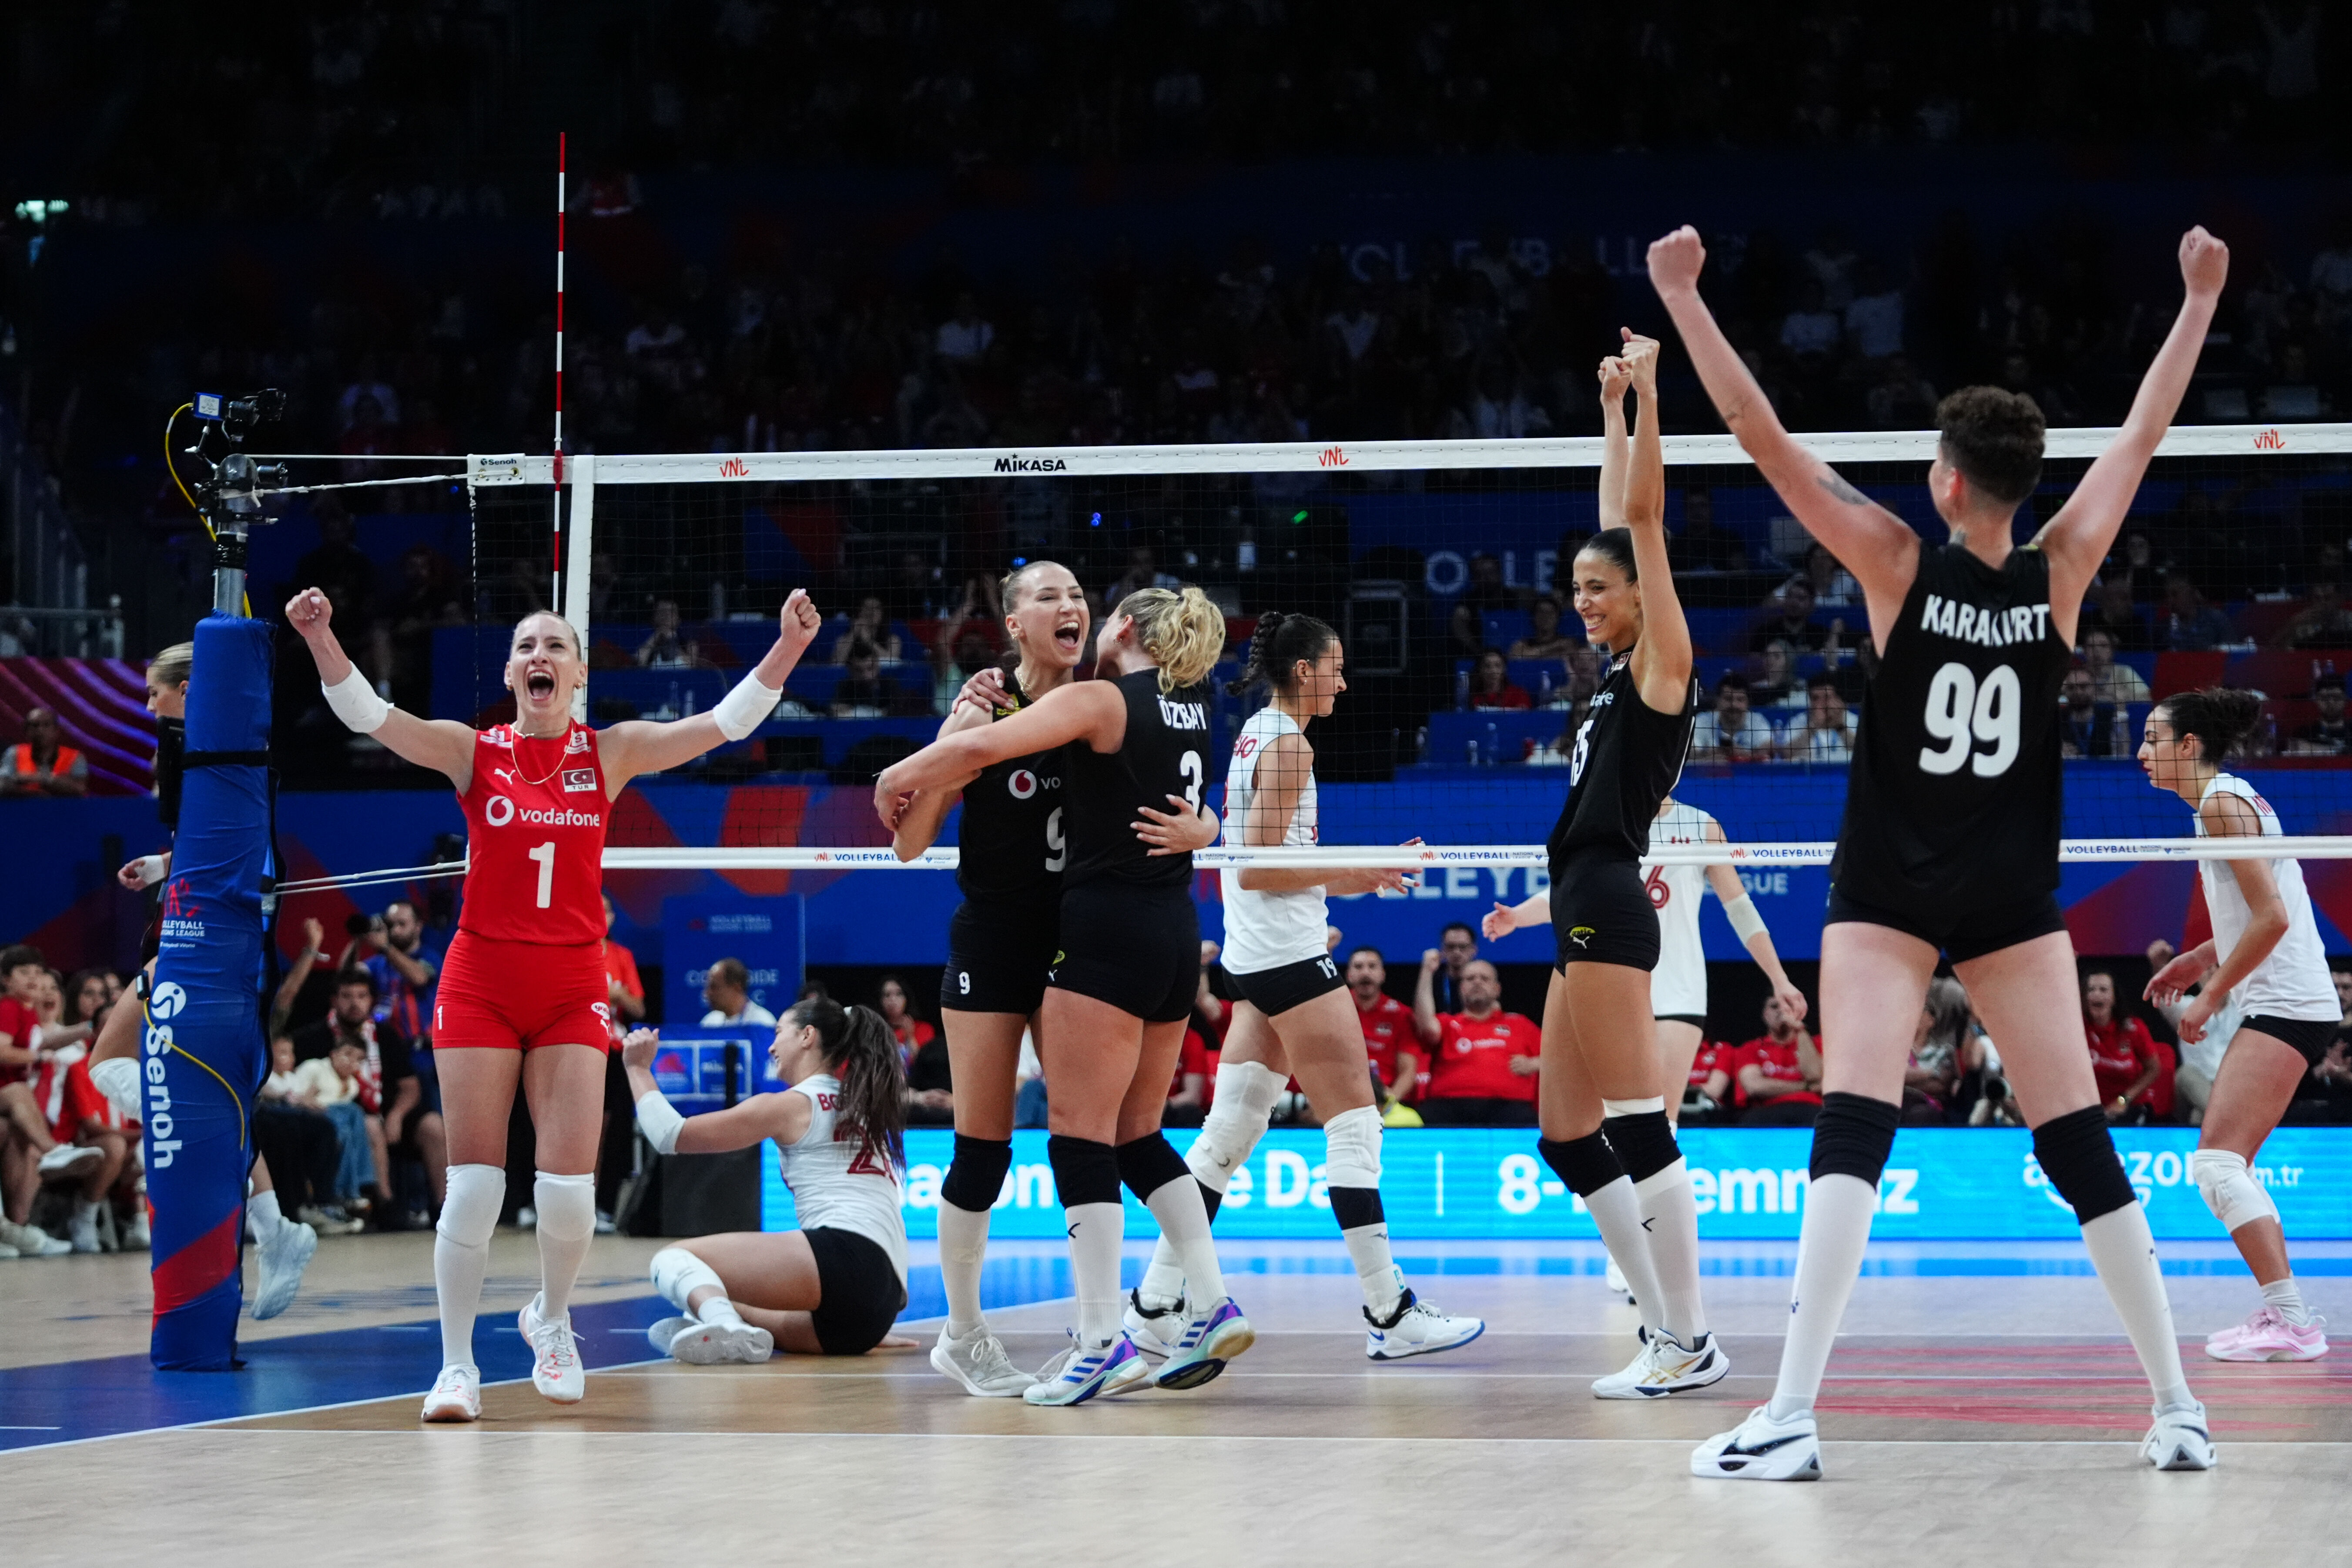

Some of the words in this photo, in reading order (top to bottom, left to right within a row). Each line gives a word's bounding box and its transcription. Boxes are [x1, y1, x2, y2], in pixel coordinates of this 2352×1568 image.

[2254, 429, 2285, 449] VNL
[720, 457, 749, 477] VNL
[1319, 446, 1349, 466] VNL
[1156, 693, 1207, 730] ÖZBAY
[1919, 662, 2021, 778] 99
[1180, 750, 1203, 818] 3
[519, 808, 600, 826] vodafone
[1420, 850, 1437, 861] VNL
[1730, 847, 1748, 858] VNL
[1752, 849, 1823, 857] VOLLEYBALL
[2067, 845, 2138, 854] VOLLEYBALL
[529, 841, 555, 908] 1
[1645, 865, 1670, 909] 6
[1316, 957, 1338, 979] 19
[959, 972, 970, 995] 9
[437, 1005, 443, 1030] 1
[146, 1024, 183, 1169] Senoh
